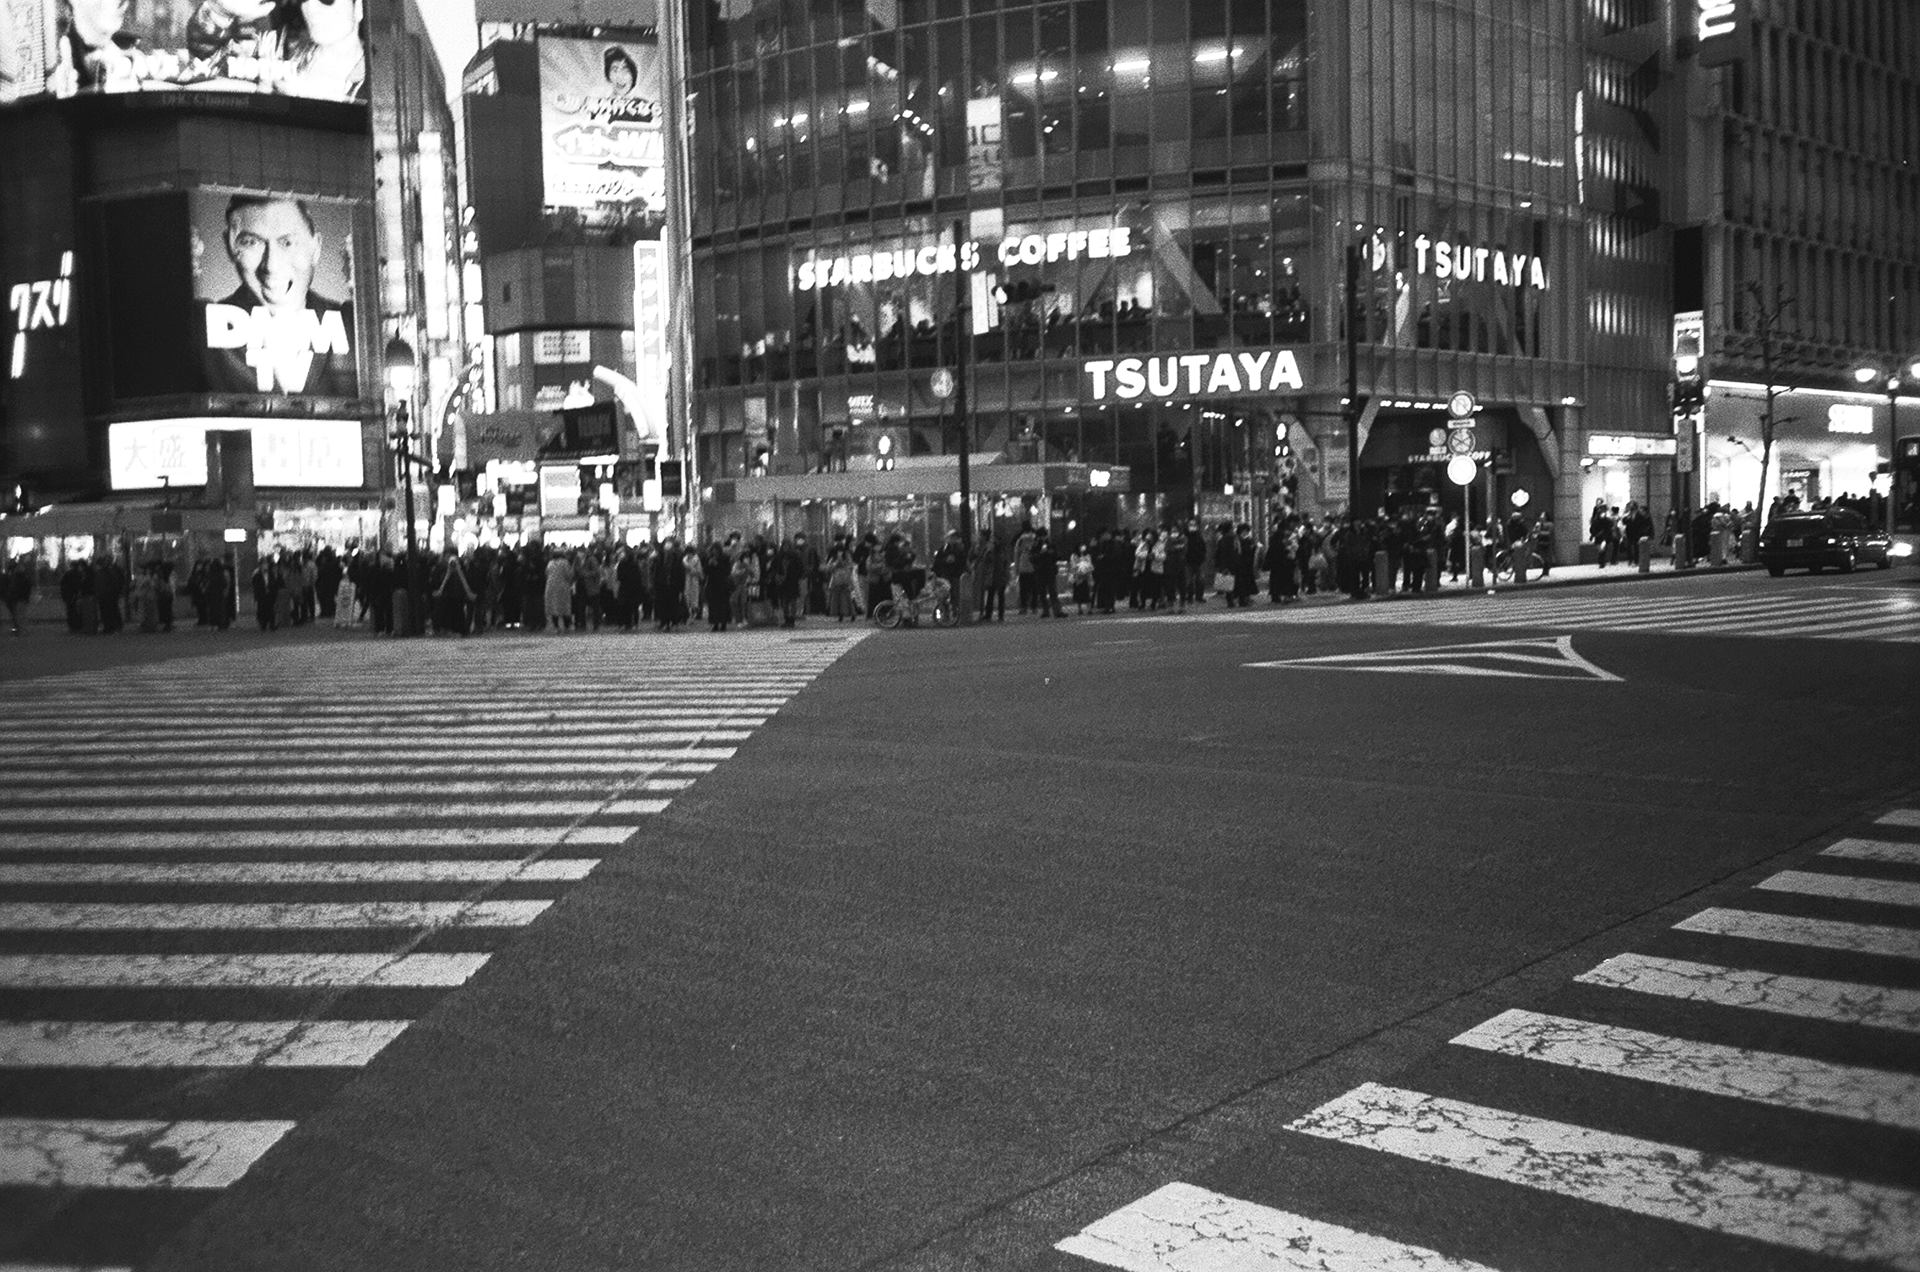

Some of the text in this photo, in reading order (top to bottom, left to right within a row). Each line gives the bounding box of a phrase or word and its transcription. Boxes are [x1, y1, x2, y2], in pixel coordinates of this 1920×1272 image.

[798, 227, 1131, 291] STARBUCKS COFFEE
[1414, 237, 1545, 290] TSUTAYA
[205, 303, 350, 355] DMM
[245, 348, 314, 393] TV
[1084, 350, 1303, 400] TSUTAYA
